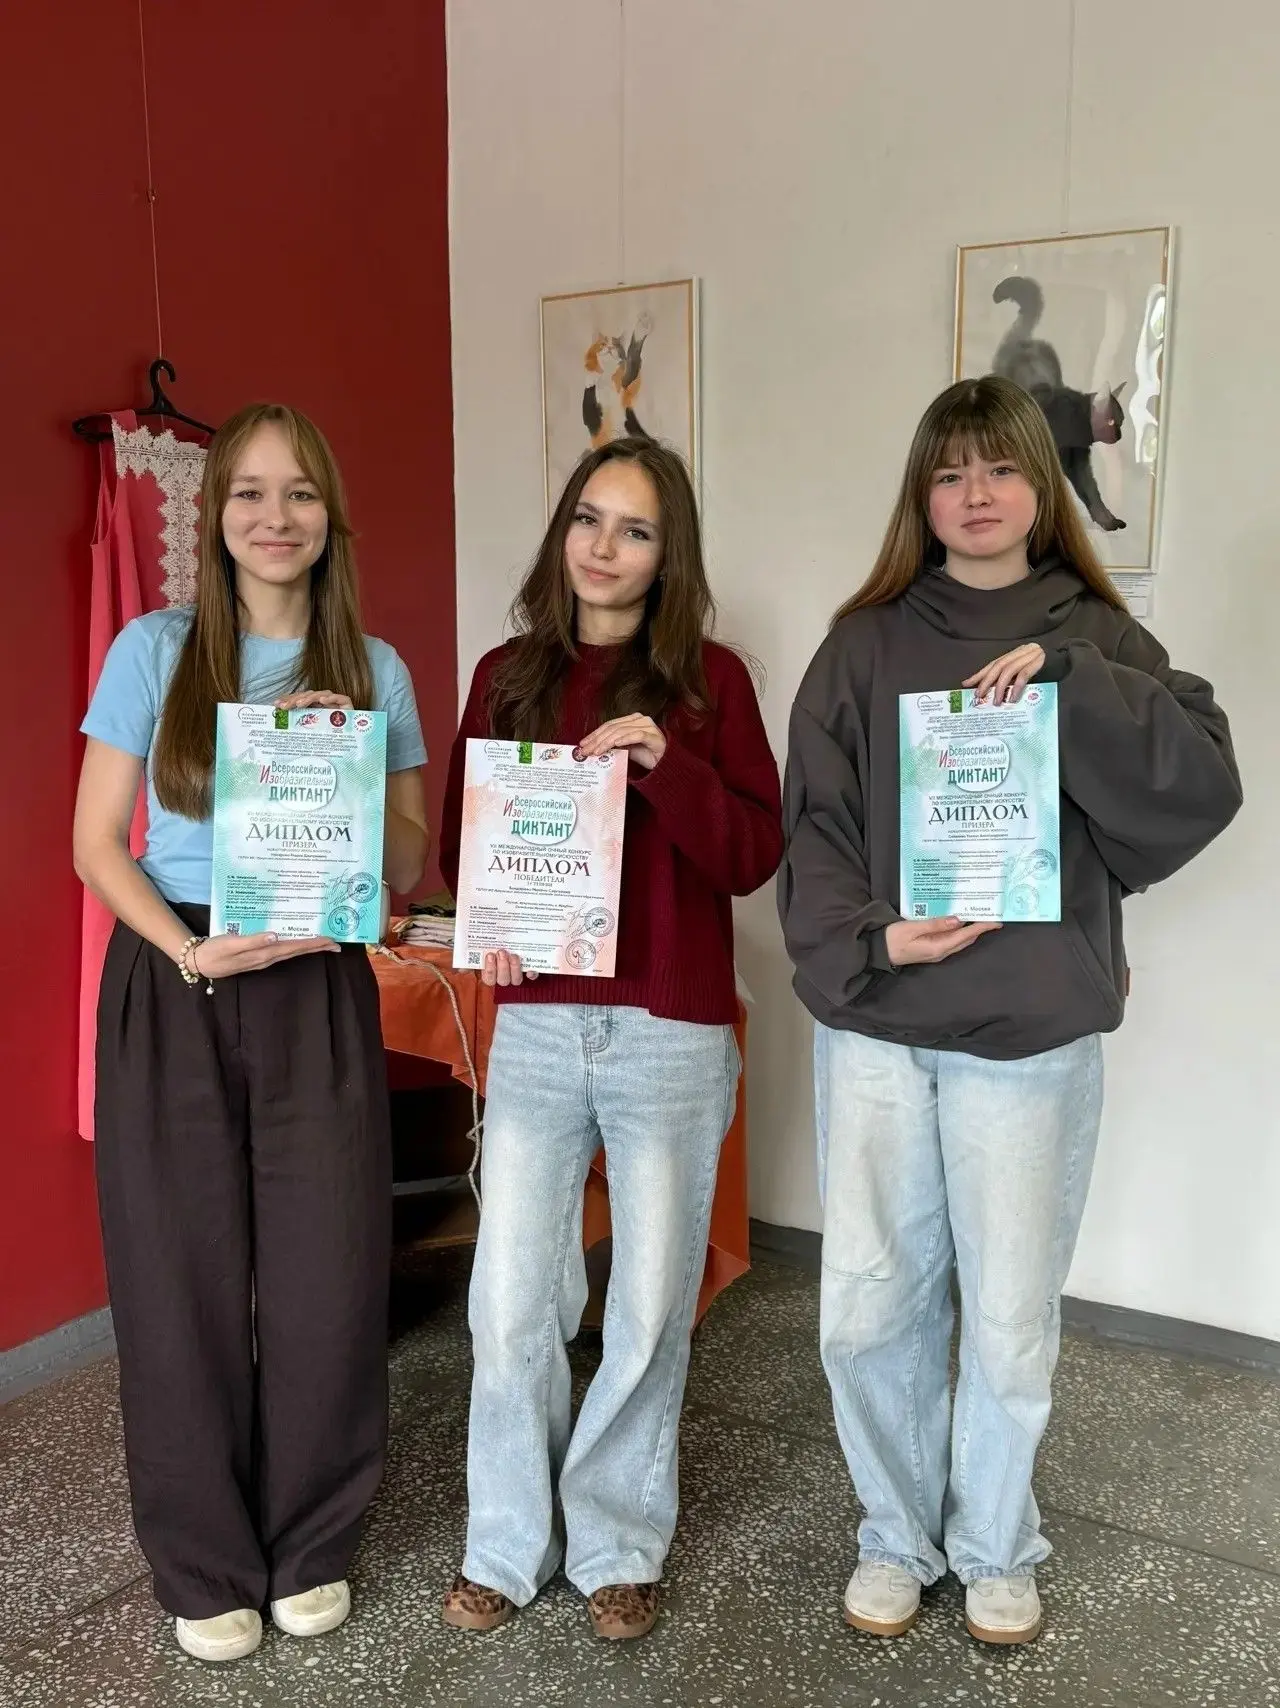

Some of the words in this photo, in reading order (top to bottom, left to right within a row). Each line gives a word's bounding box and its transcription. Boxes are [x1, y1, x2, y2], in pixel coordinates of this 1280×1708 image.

[938, 749, 1007, 768] Изобразительный
[949, 744, 1005, 757] Всероссийский
[260, 765, 334, 786] Изобразительный
[271, 761, 332, 775] Всероссийский
[948, 767, 1006, 785] ДИКТАНТ
[269, 787, 332, 803] ДИКТАНТ
[514, 795, 572, 810] Всероссийский
[503, 799, 574, 821] Изобразительный
[928, 804, 1029, 825] ДИПЛОМ
[245, 823, 353, 842] ДИПЛОМ
[511, 820, 572, 838] ДИКТАНТ
[488, 856, 591, 876] ДИПЛОМ
[514, 874, 564, 883] ПОБЕДИТЕЛЯ
